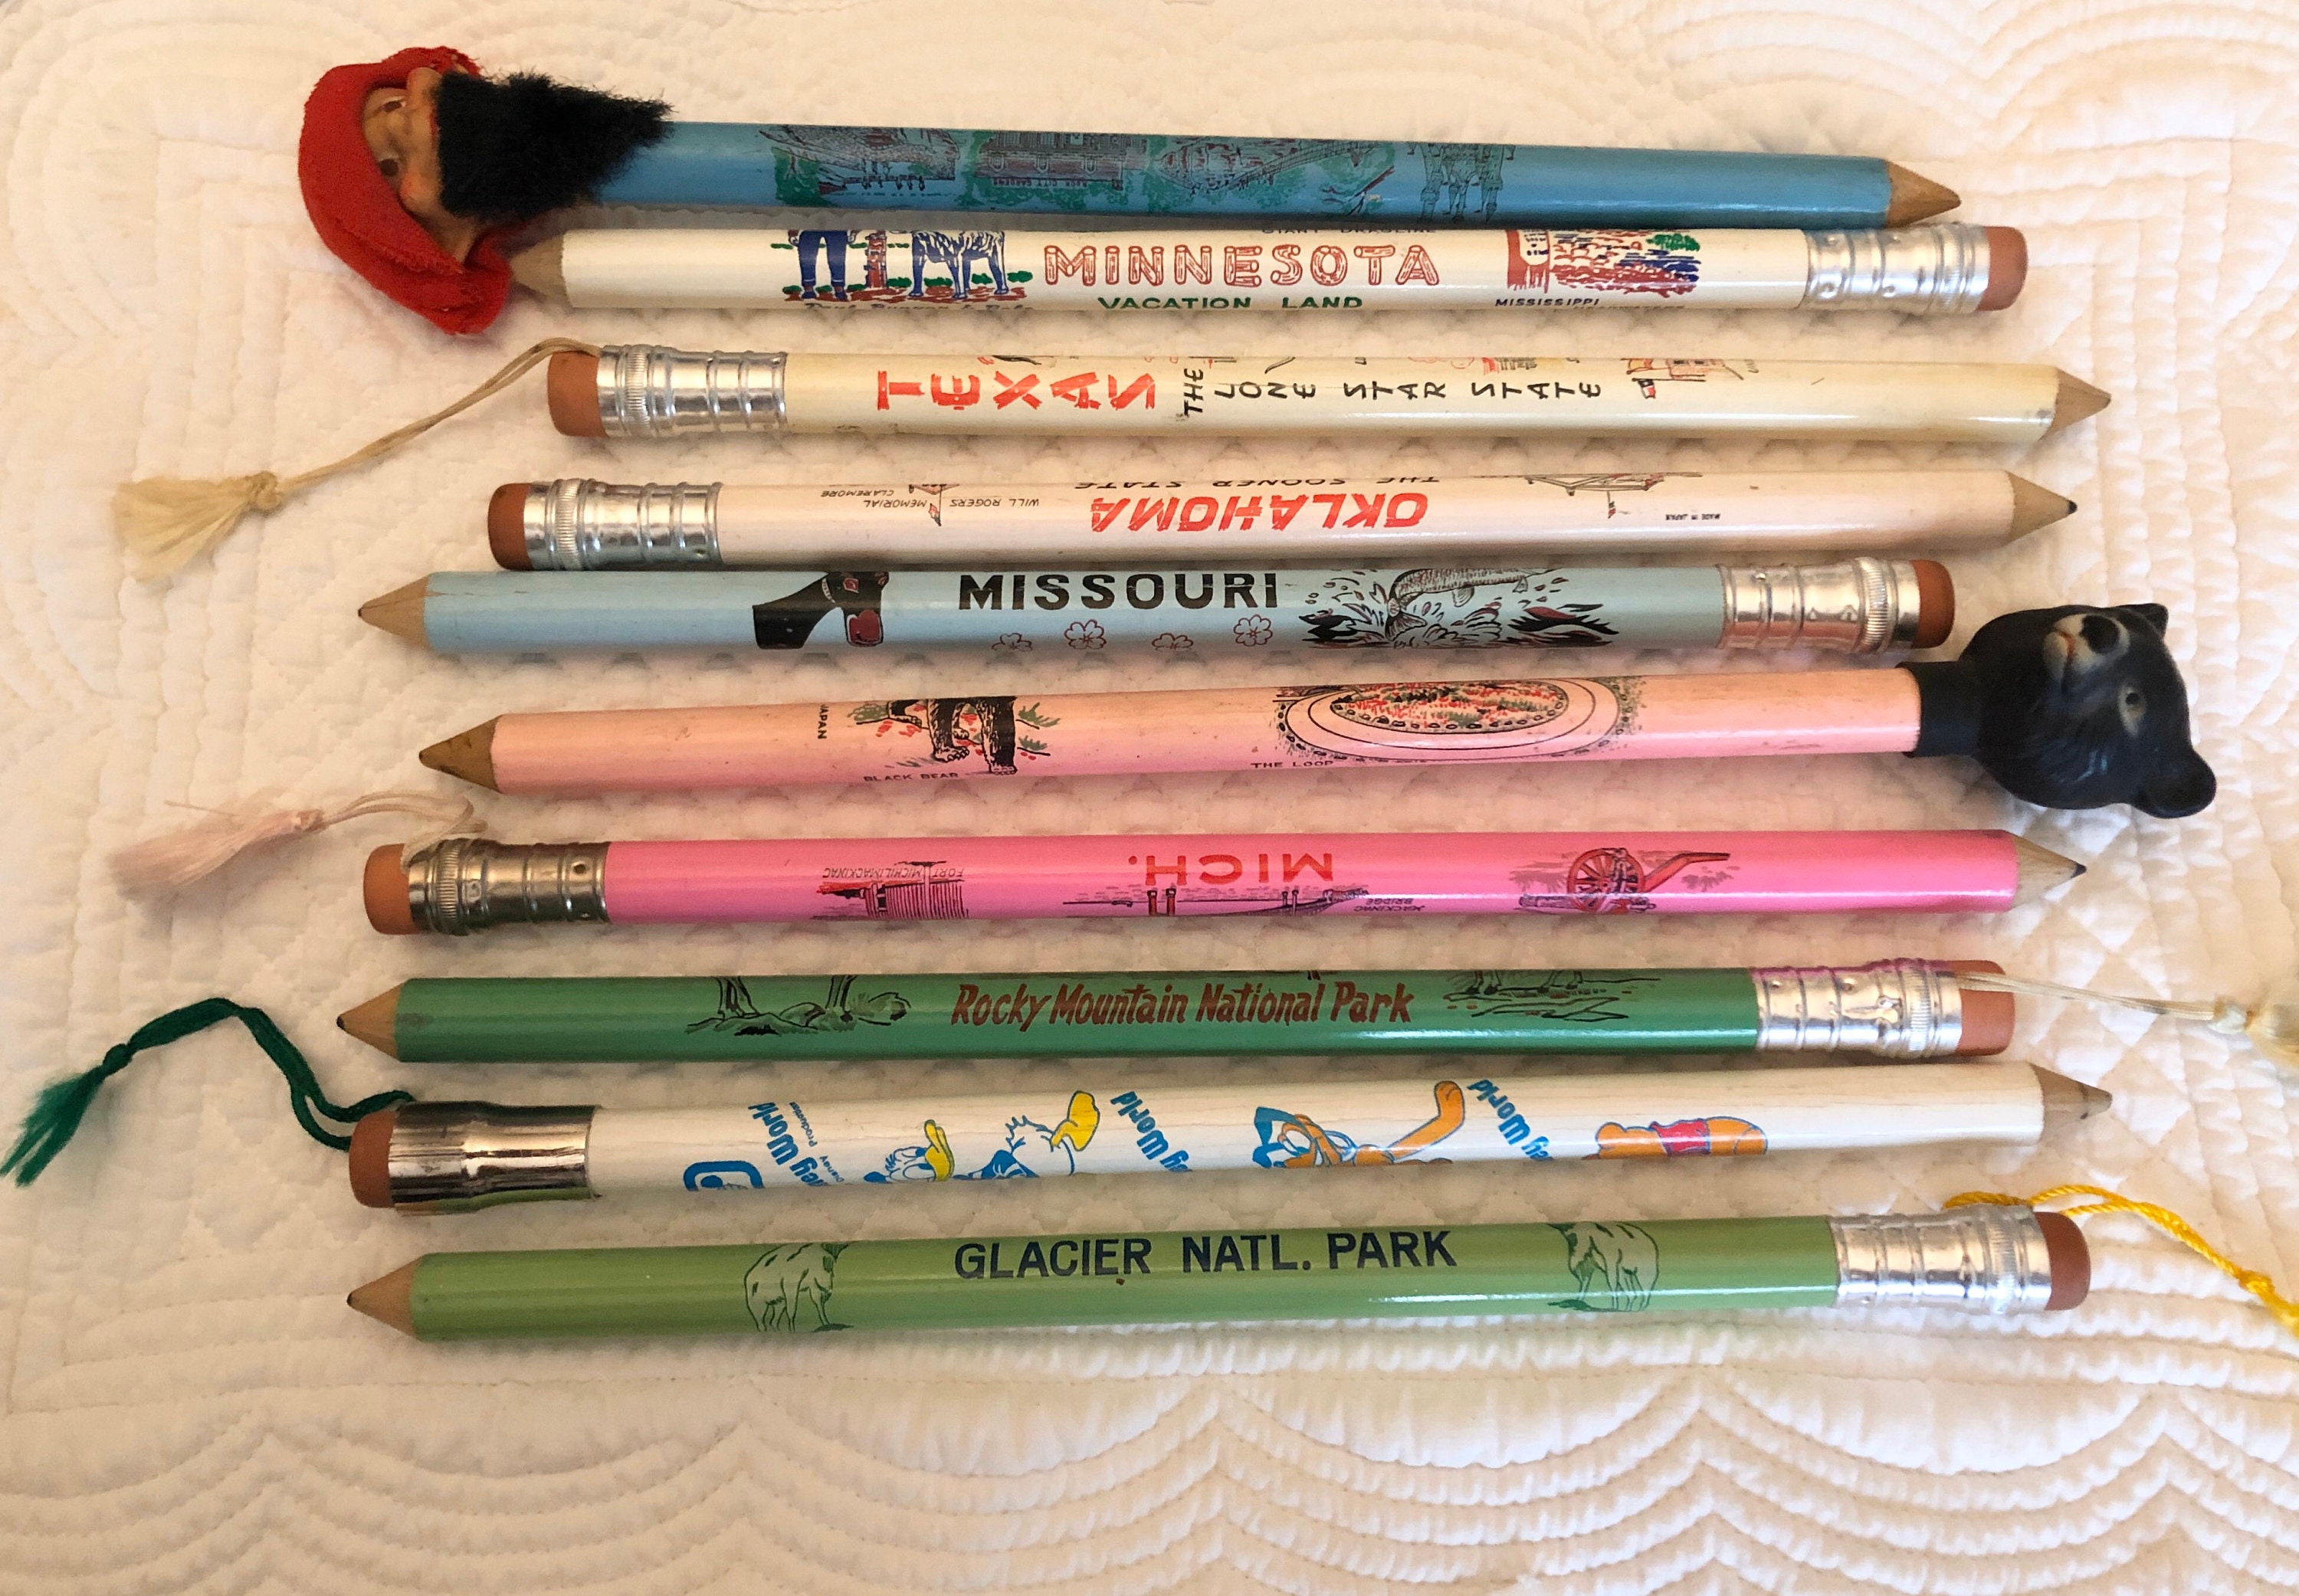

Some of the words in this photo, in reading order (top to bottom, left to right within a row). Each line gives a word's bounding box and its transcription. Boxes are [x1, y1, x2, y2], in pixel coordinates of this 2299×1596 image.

[1044, 244, 1440, 287] MINNESOTA
[1098, 296, 1251, 309] VACATION
[1281, 296, 1362, 309] LAND
[1495, 297, 1599, 306] MISSISSIPPI
[877, 370, 1156, 411] TEXAS
[1183, 368, 1204, 417] THE
[1214, 381, 1316, 399] LONE
[1343, 381, 1446, 400] STAR
[1471, 381, 1601, 399] STATE
[864, 499, 927, 508] MEMORIAL
[949, 498, 1002, 507] ROGERS
[1008, 498, 1040, 507] WILL
[1090, 493, 1428, 533] OKLAHOMA
[958, 572, 1278, 611] MISSOURI
[817, 703, 829, 740] JAPAN
[864, 773, 913, 782] BLACK
[920, 772, 959, 780] BEAR
[932, 867, 965, 878] FORT
[1128, 852, 1333, 886] MICH.
[951, 982, 1053, 1033] Rocky
[1049, 984, 1187, 1025] Mountain
[1195, 982, 1325, 1026] National
[1330, 981, 1414, 1024] Park
[1110, 1090, 1169, 1160] World
[1467, 1080, 1530, 1145] World
[748, 1102, 799, 1165] World
[955, 1238, 1152, 1280] GLACIER
[1182, 1234, 1311, 1273] NATL.
[1327, 1230, 1457, 1269] PARK
